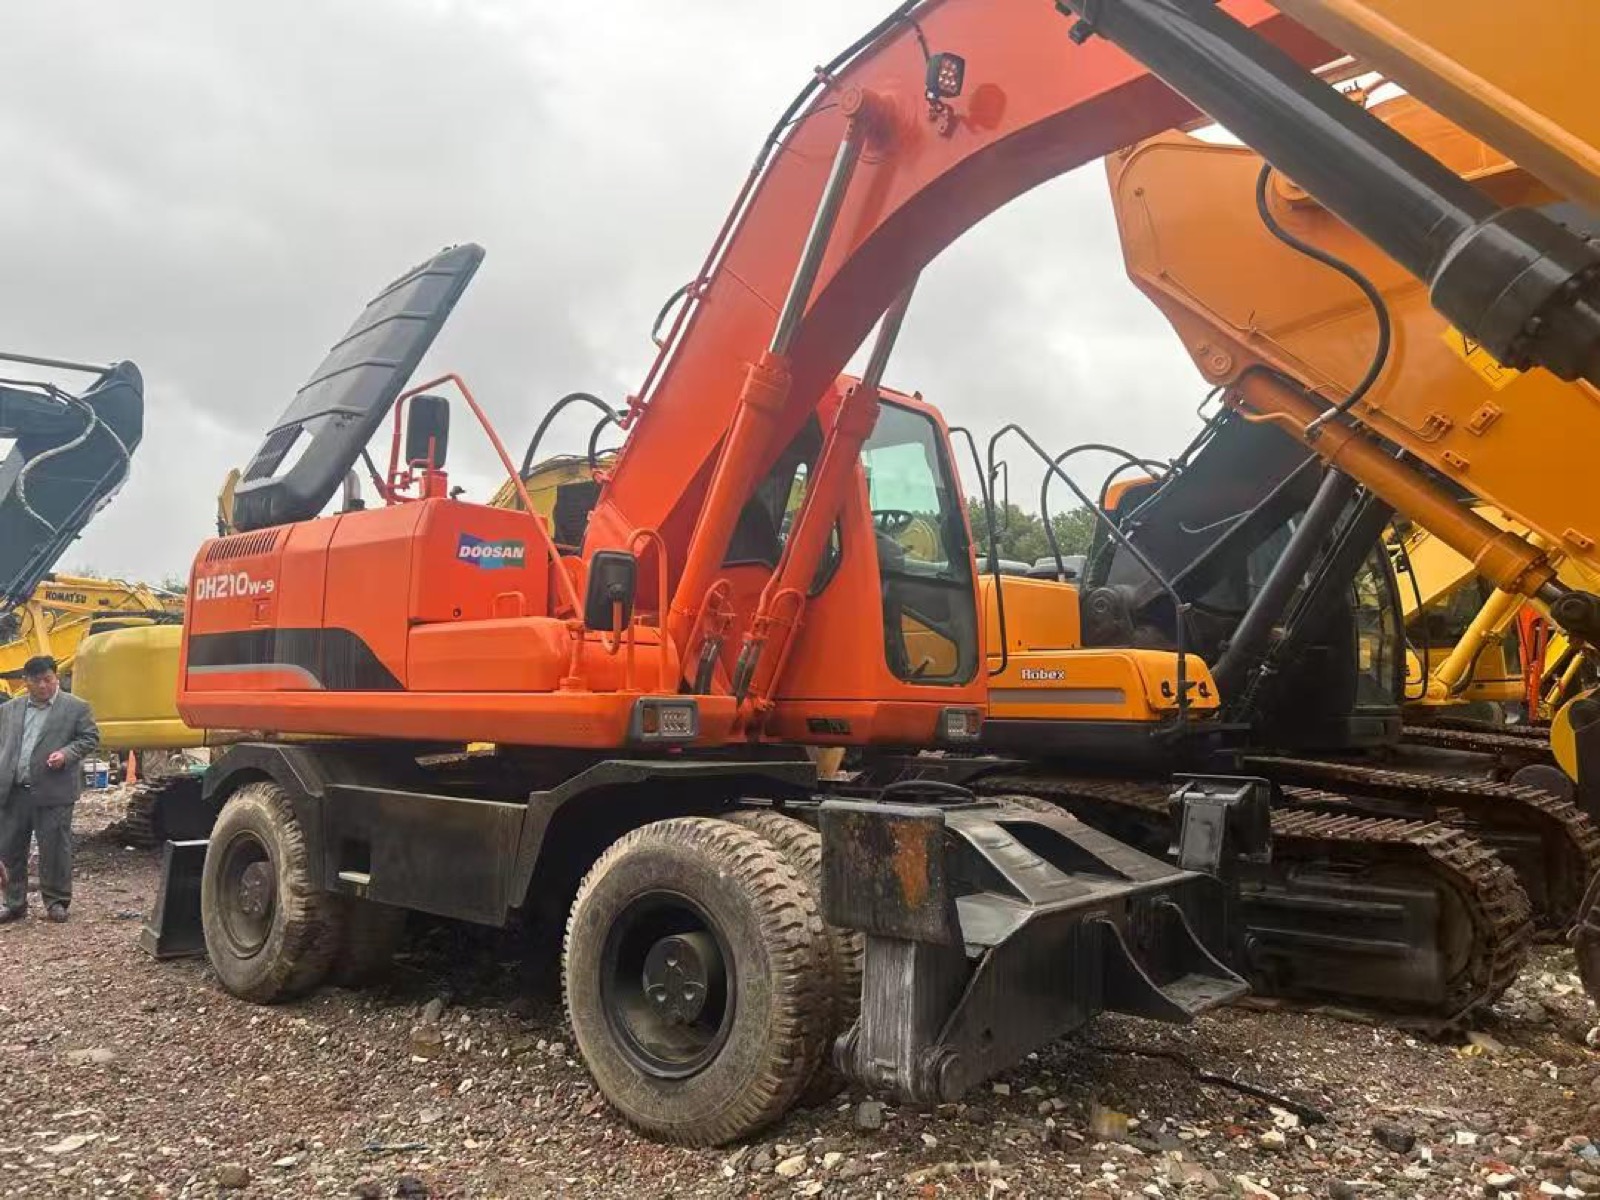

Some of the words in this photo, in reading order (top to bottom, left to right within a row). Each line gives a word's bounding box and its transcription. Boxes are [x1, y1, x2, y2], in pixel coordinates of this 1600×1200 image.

[459, 545, 524, 558] DOOSAN
[45, 591, 87, 604] KOMATSU
[1021, 668, 1065, 680] Robex
